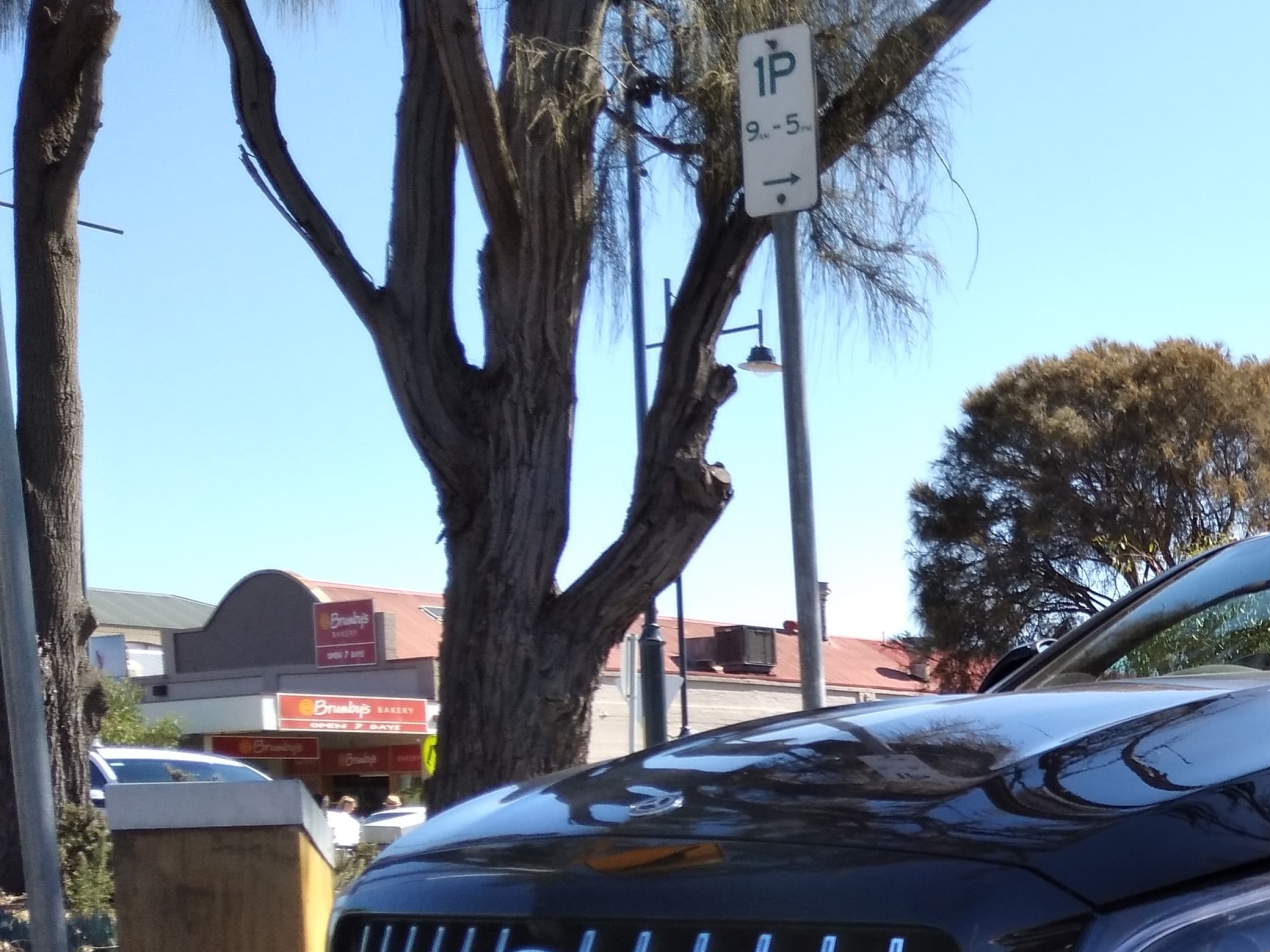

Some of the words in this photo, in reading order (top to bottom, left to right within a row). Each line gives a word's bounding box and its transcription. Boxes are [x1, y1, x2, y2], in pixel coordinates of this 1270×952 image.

[753, 51, 796, 97] 1P
[314, 699, 372, 719] Brumby's
[377, 706, 414, 714] BAKERY
[310, 722, 347, 730] OPEN
